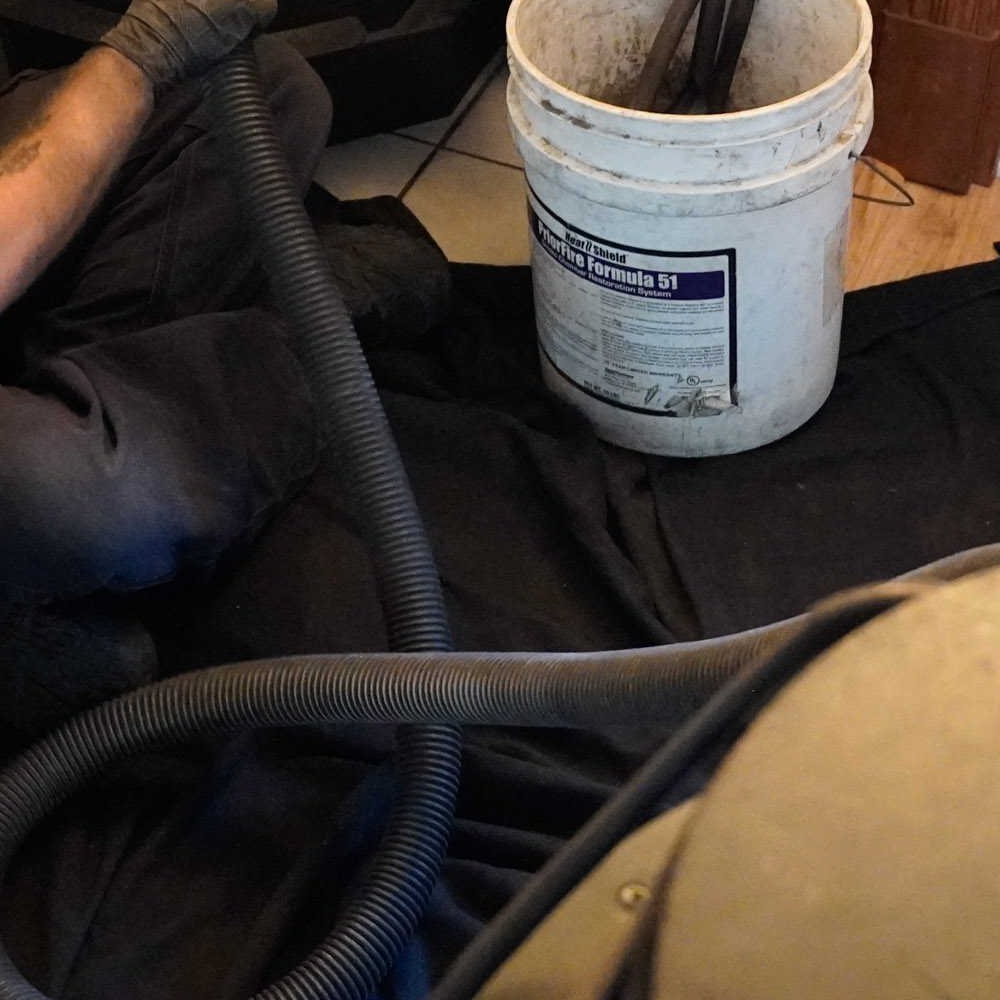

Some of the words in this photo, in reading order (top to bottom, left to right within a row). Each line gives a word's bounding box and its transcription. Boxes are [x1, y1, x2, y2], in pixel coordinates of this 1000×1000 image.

[593, 244, 627, 265] Shield
[587, 256, 655, 289] Formula
[658, 273, 678, 291] 51
[588, 271, 636, 294] Restoration
[637, 287, 672, 299] System
